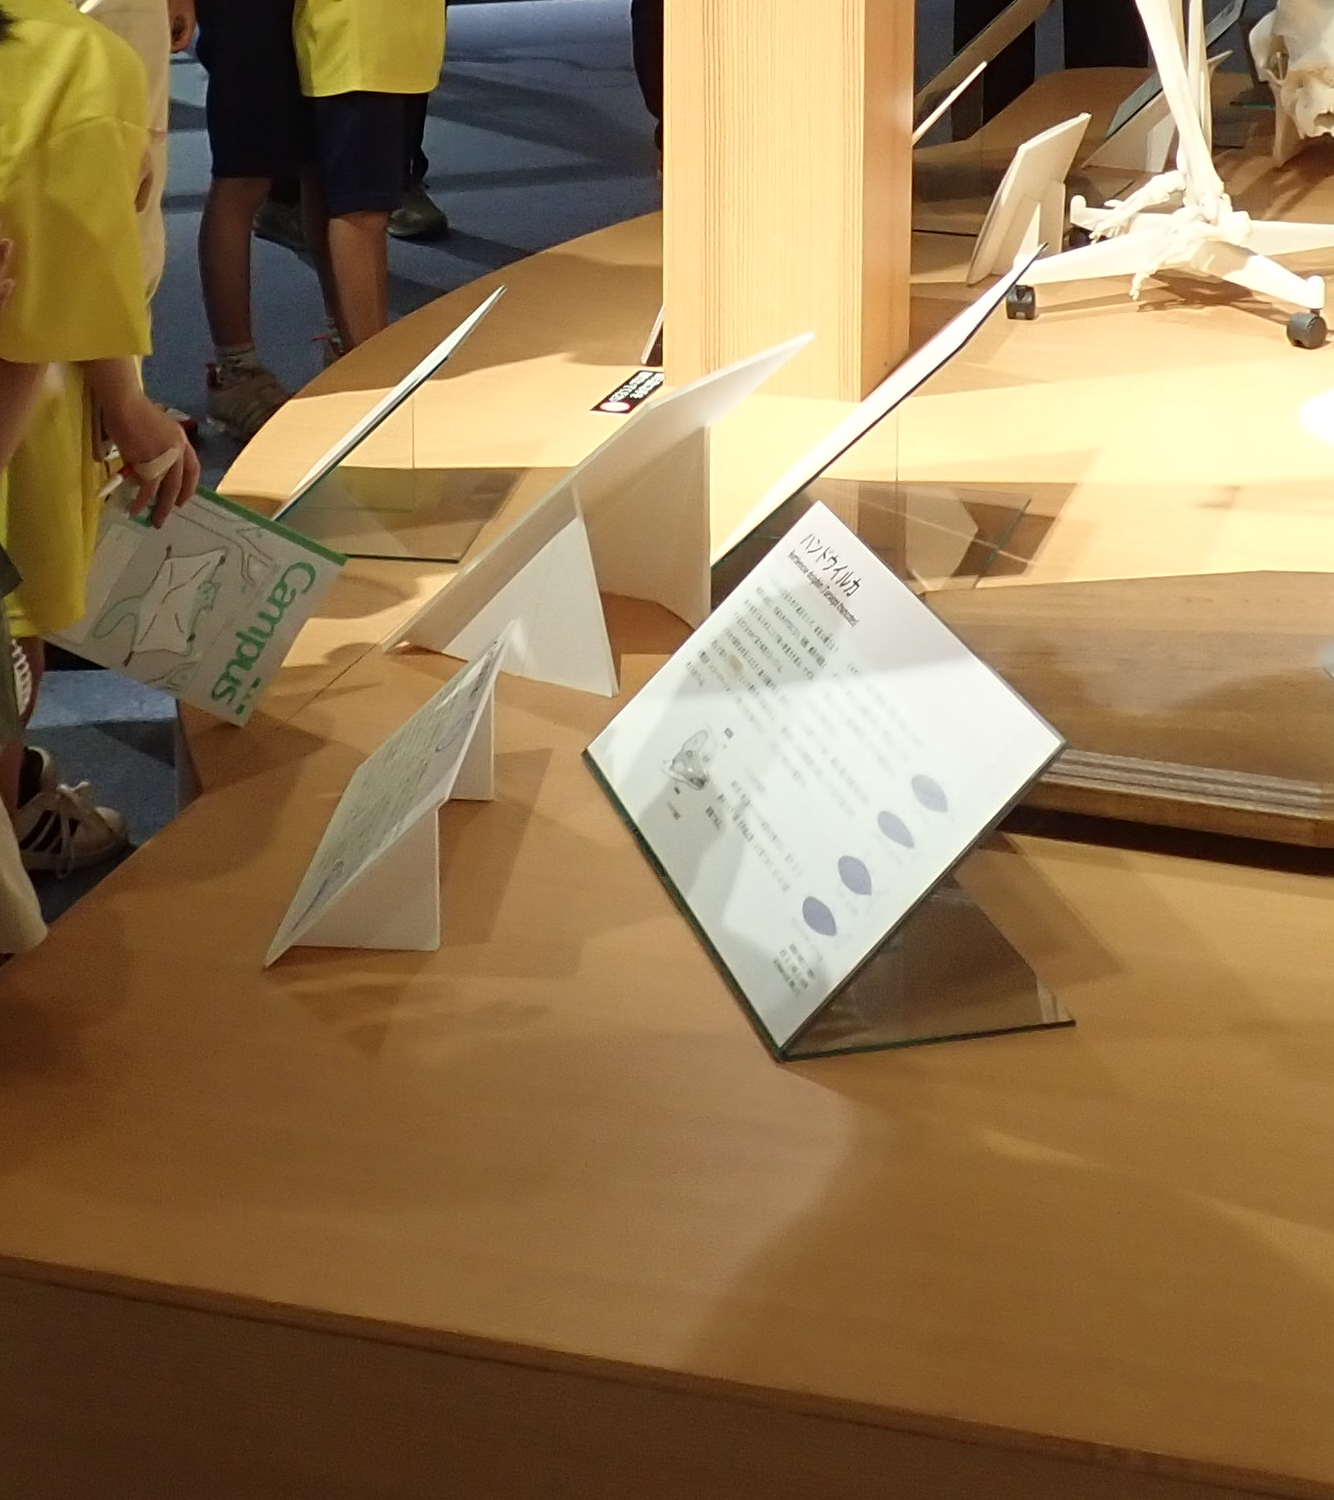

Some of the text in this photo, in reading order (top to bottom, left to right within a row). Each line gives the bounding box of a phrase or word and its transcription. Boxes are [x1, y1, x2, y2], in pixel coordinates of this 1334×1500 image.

[799, 532, 862, 598] ハンドウイルカ
[211, 561, 317, 705] Campus
